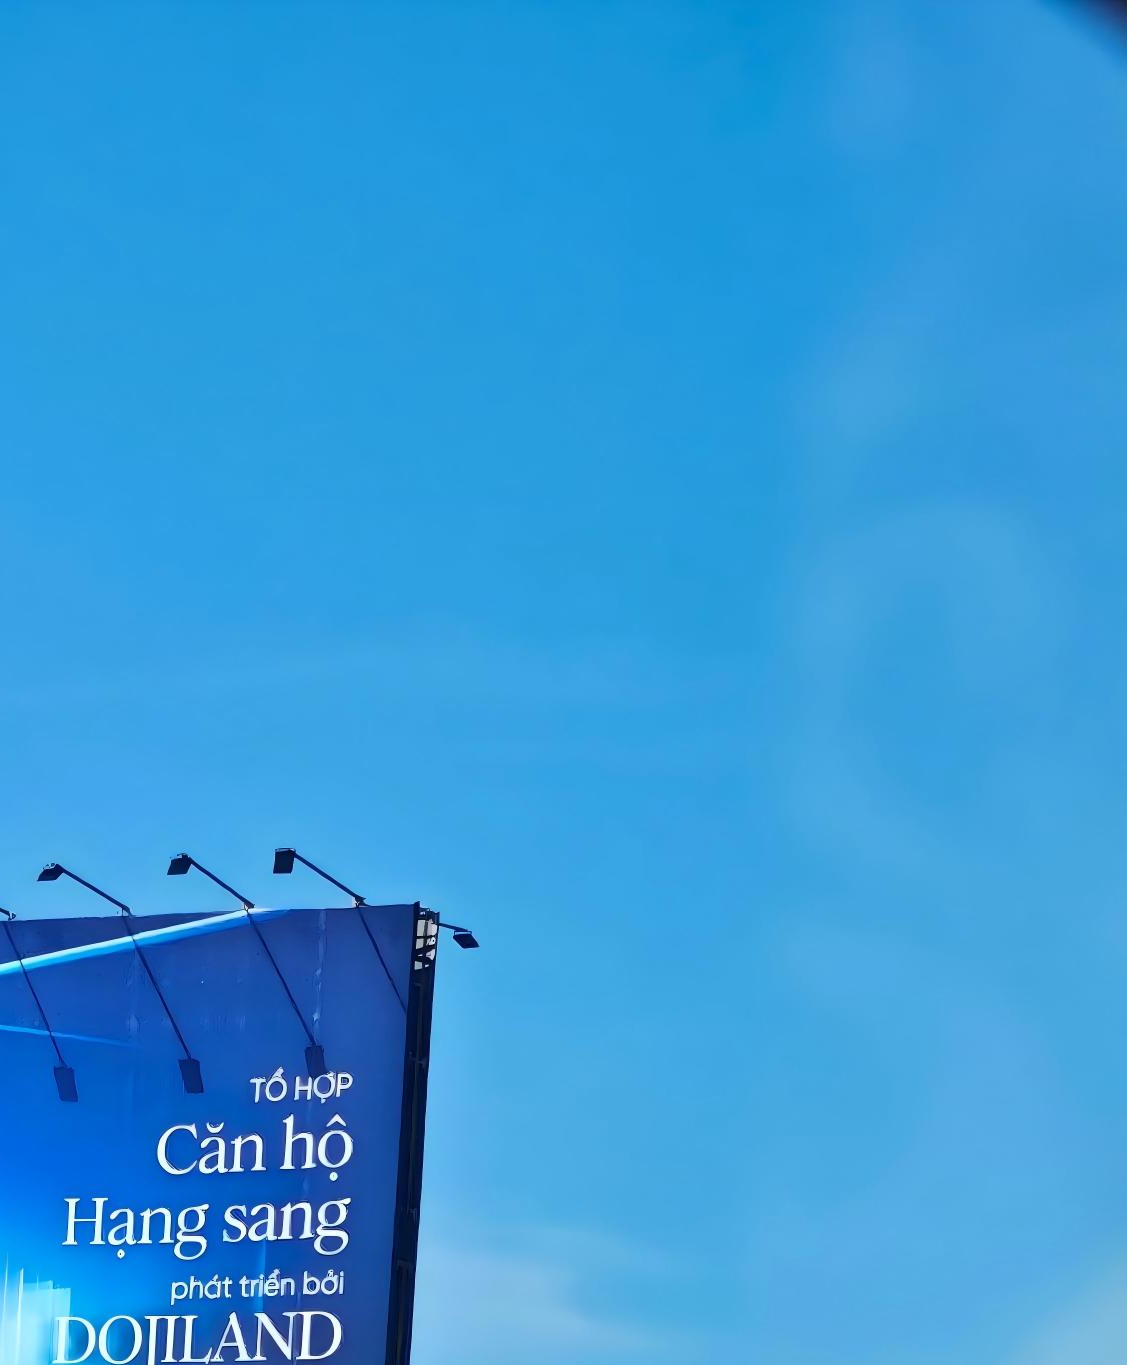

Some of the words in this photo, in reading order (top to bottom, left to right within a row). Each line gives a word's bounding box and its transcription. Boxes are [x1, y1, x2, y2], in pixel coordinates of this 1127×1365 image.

[294, 1070, 354, 1104] HỢP
[156, 1121, 265, 1176] Căn
[280, 1114, 354, 1181] hộ
[62, 1197, 210, 1261] Hạng
[222, 1197, 352, 1256] sang
[170, 1274, 233, 1306] phát
[303, 1269, 344, 1295] bởi
